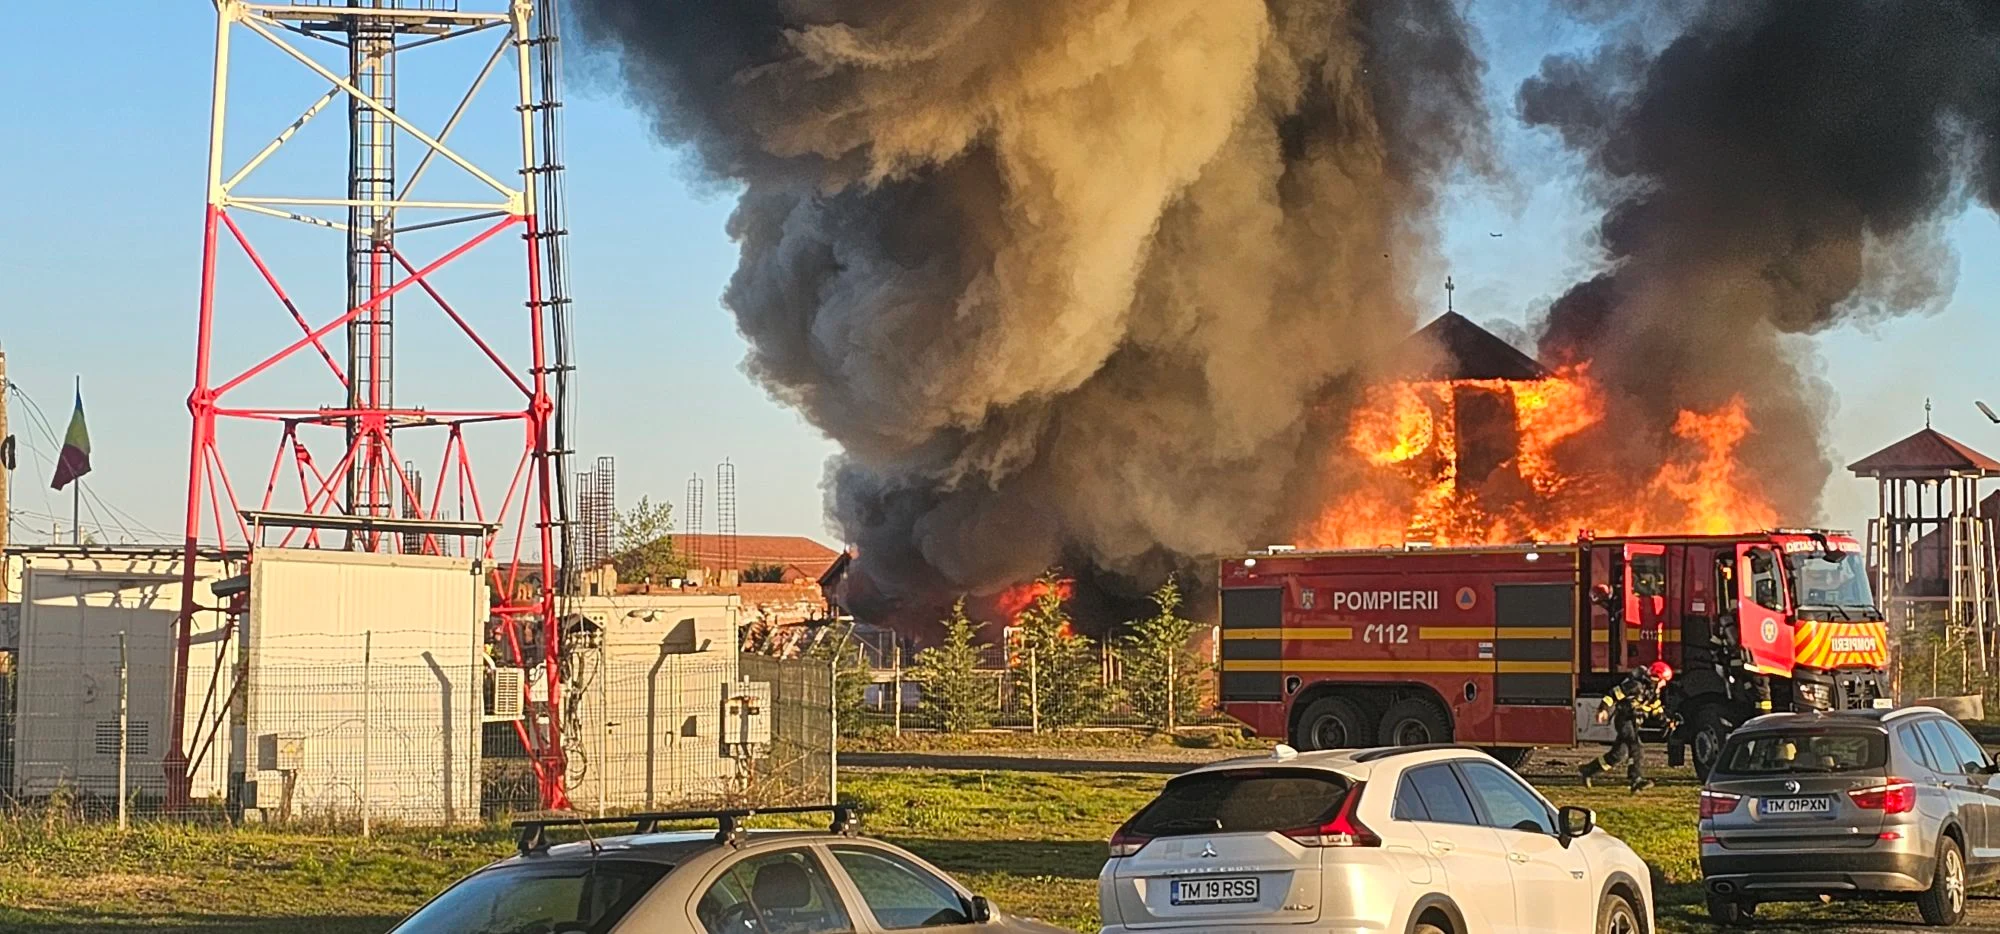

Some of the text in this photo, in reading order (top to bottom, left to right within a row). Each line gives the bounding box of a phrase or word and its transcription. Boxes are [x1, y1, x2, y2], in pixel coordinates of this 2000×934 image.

[1333, 590, 1438, 611] POMPIERII
[1375, 623, 1409, 644] 112
[1768, 800, 1785, 812] TM
[1180, 880, 1255, 899] TM 19 RSS
